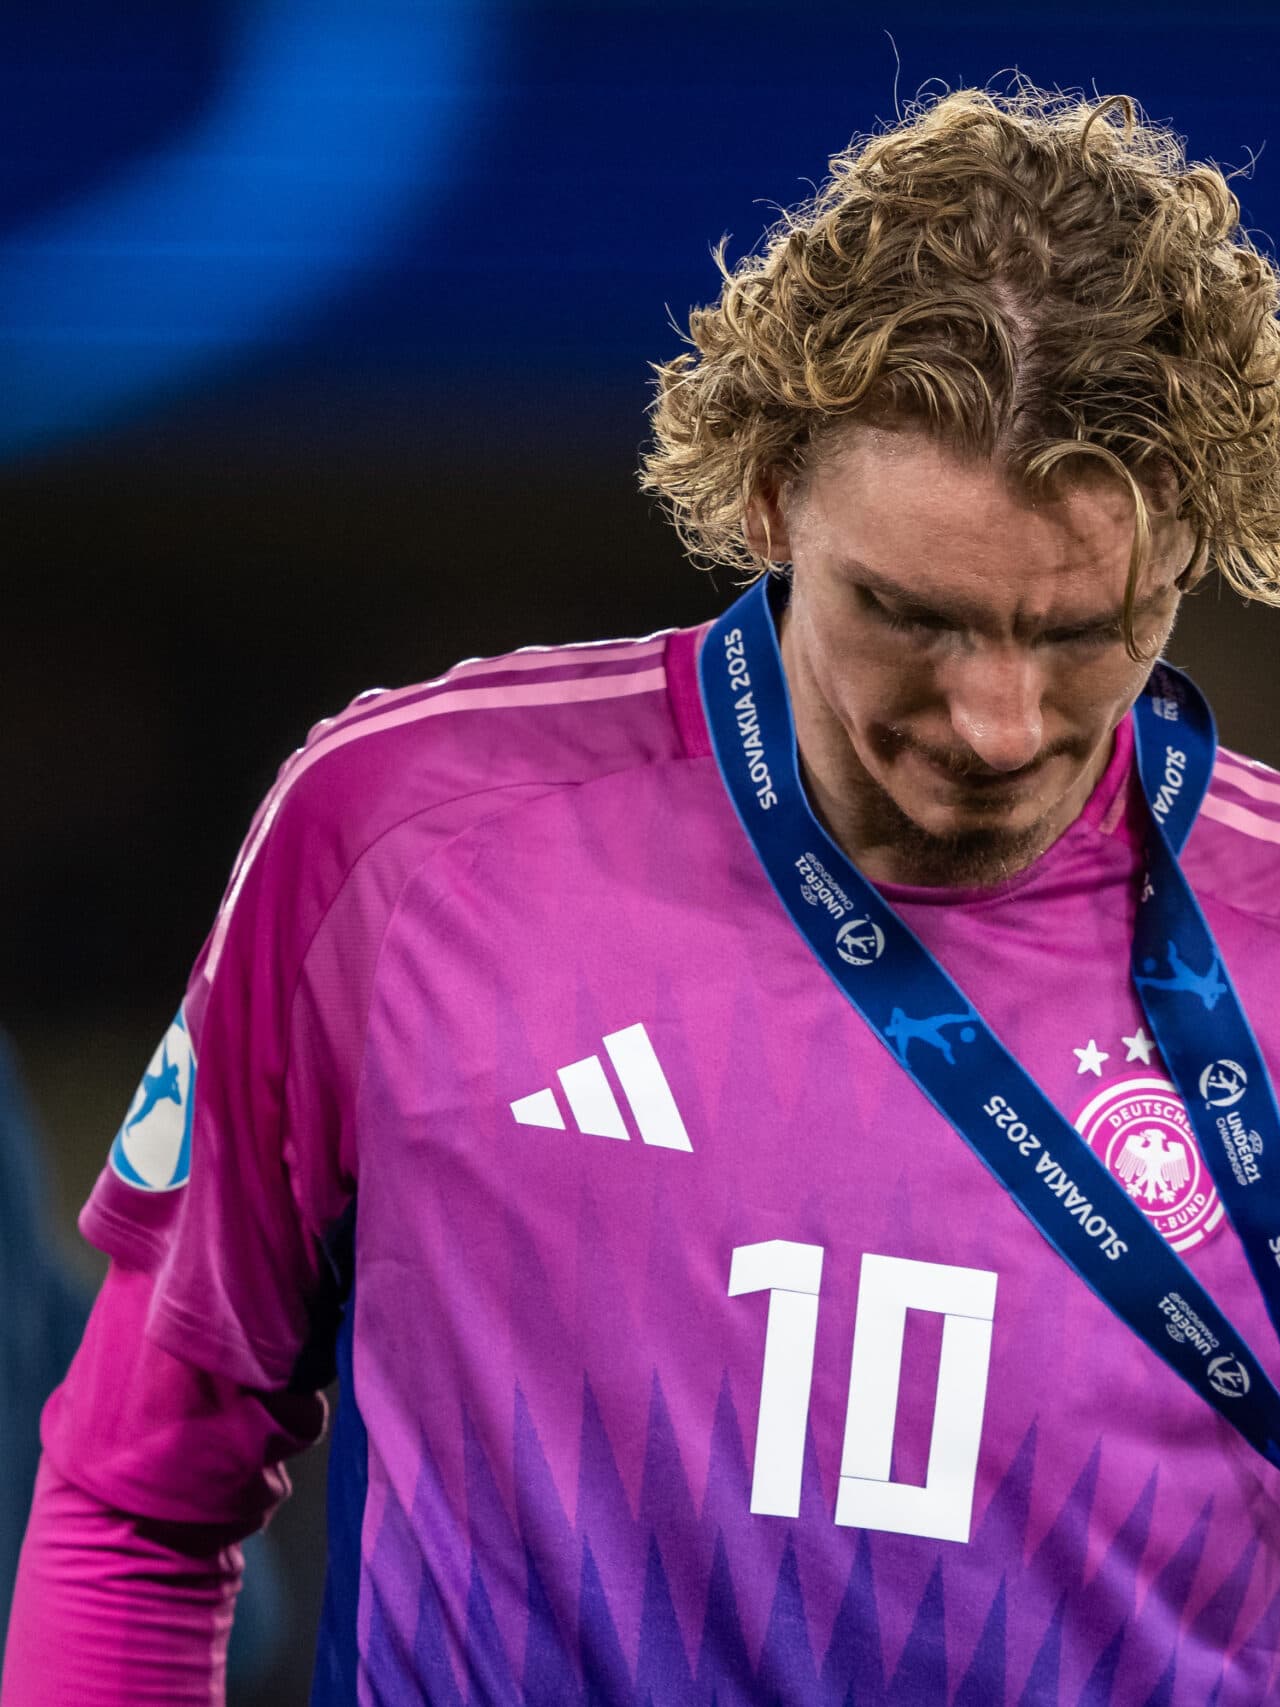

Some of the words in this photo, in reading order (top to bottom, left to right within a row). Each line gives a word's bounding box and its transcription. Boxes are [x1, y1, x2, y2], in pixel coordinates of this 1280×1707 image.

[724, 628, 751, 690] 2025
[735, 691, 778, 810] SLOVAKIA
[795, 855, 845, 919] UNDER21
[983, 1095, 1041, 1156] 2025
[1226, 1111, 1261, 1183] UNDER21
[1035, 1151, 1128, 1260] SLOVAKIA
[1158, 1296, 1212, 1356] UNDER21
[728, 1239, 998, 1543] 10
